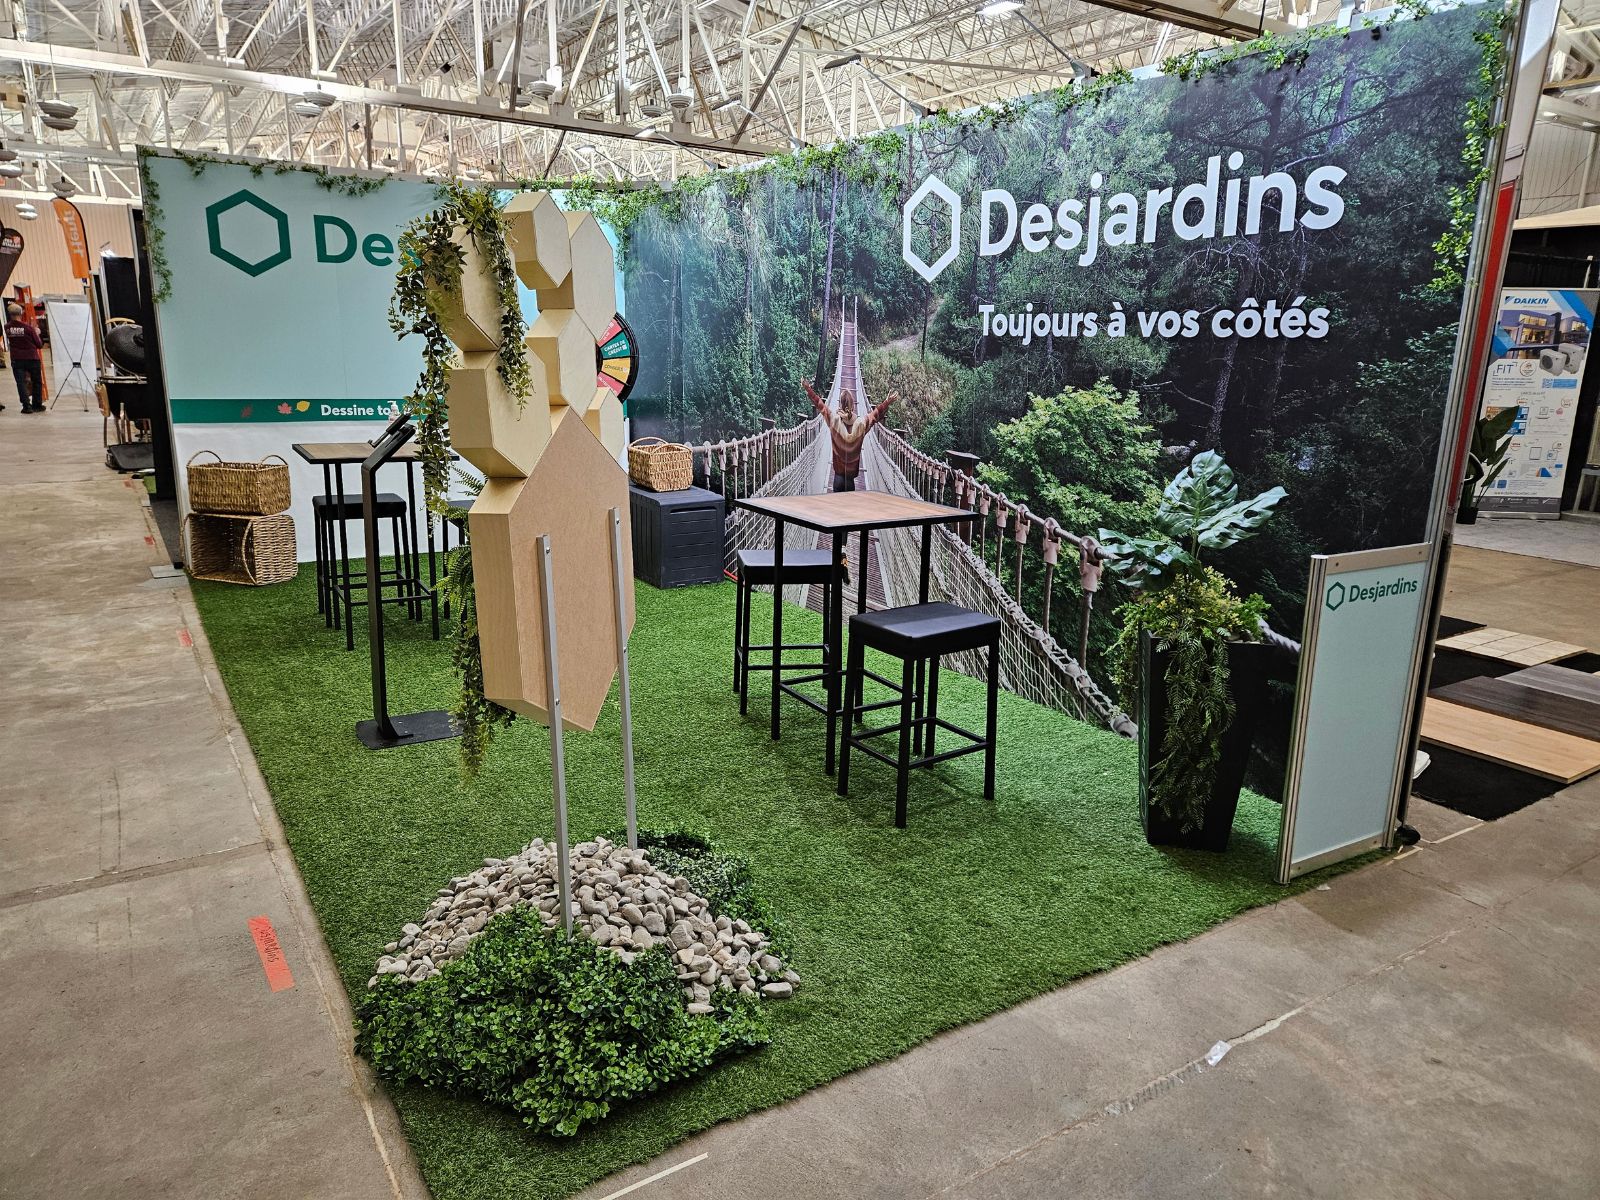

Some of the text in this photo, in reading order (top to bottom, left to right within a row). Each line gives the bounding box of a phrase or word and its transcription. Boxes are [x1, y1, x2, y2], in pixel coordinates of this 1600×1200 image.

[980, 151, 1348, 267] Desjardins
[313, 214, 421, 267] De
[978, 296, 1331, 346] Toujours à vos côtés
[1496, 364, 1514, 374] FIT
[320, 404, 391, 416] Dessine to
[1349, 577, 1418, 603] Desjardins
